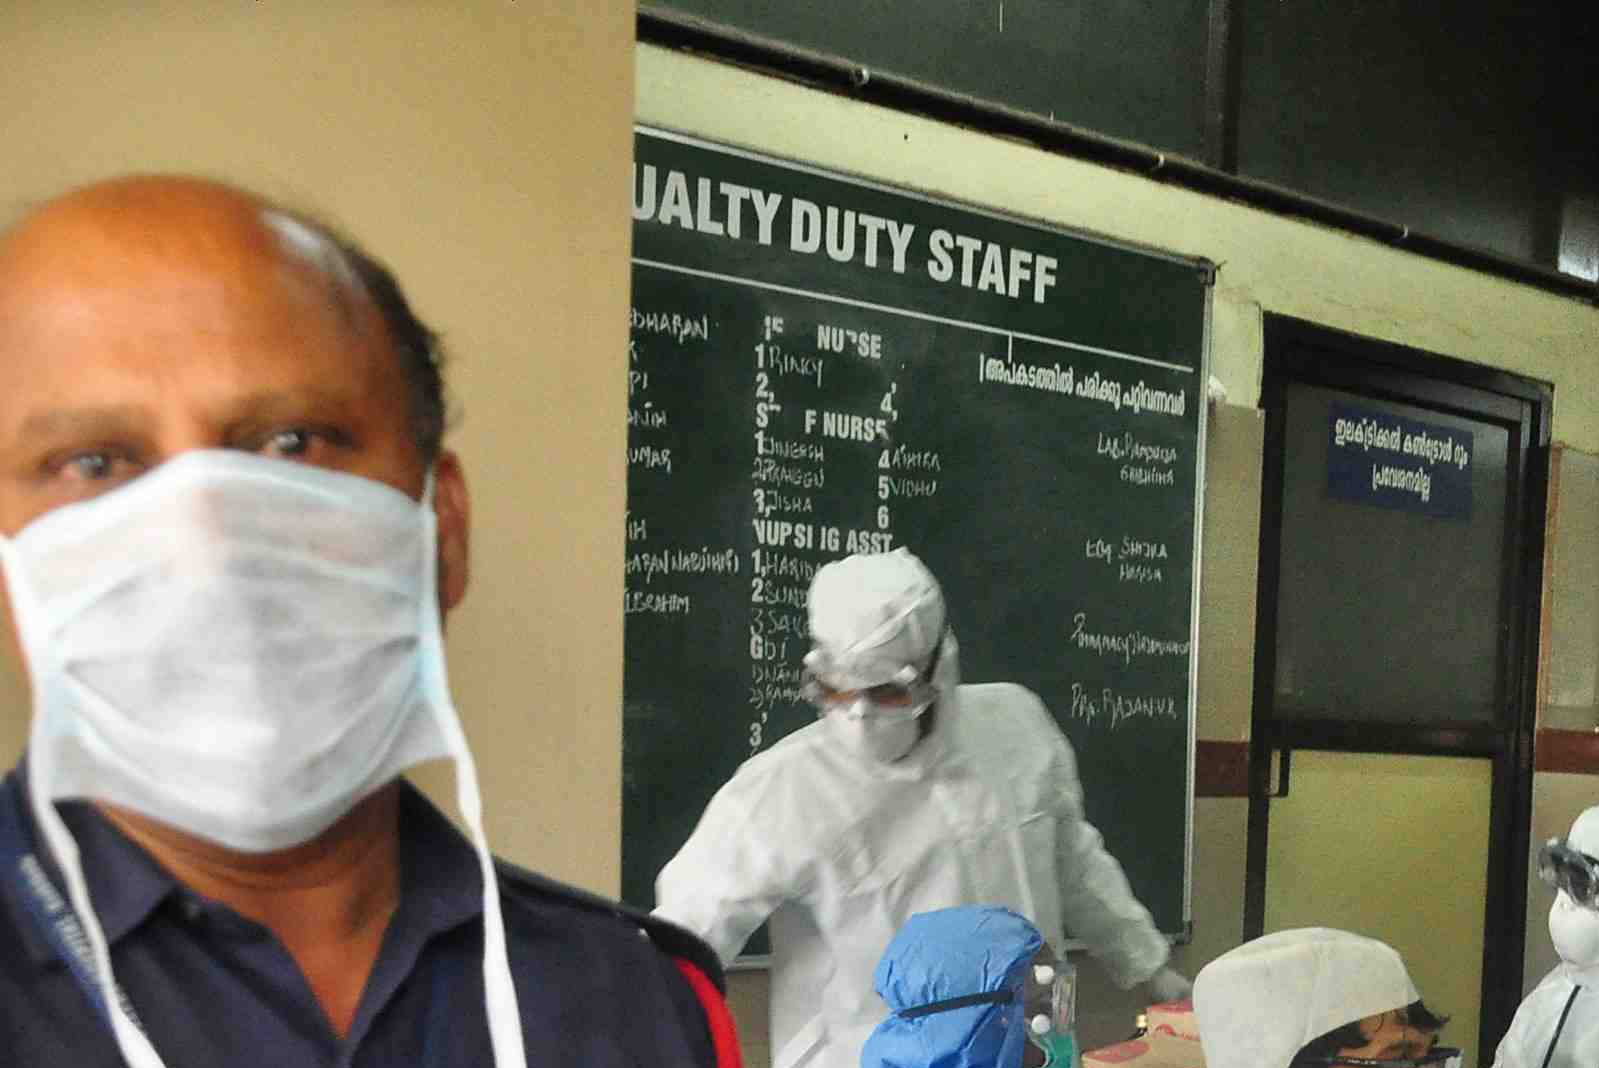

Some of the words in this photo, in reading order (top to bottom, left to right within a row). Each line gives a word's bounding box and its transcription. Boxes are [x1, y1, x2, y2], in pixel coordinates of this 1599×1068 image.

[791, 199, 915, 274] DUTY
[926, 228, 1058, 303] STAFF
[878, 475, 890, 500] 5
[877, 505, 889, 530] 6
